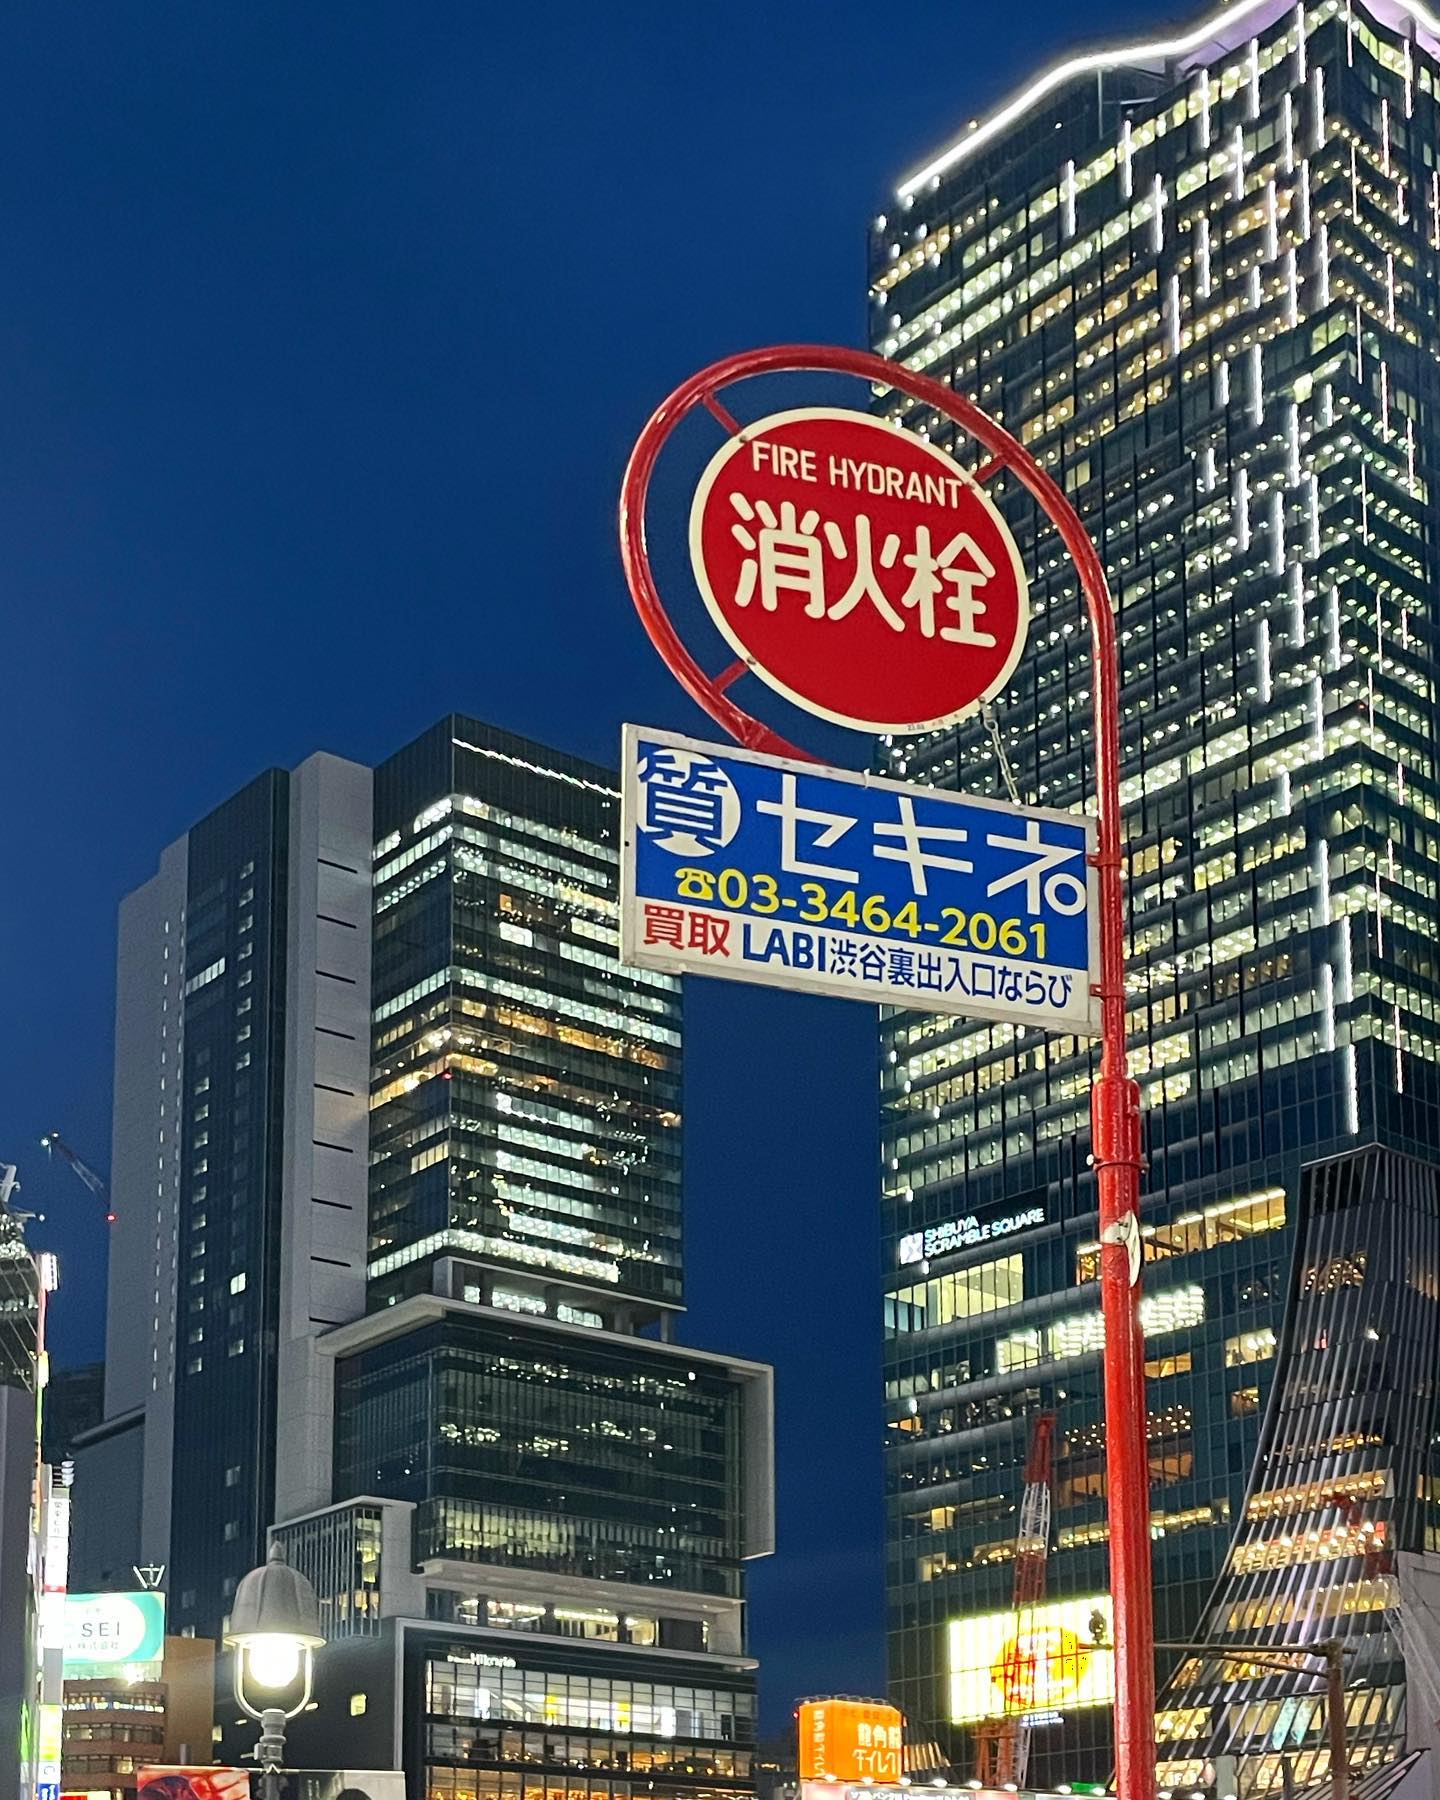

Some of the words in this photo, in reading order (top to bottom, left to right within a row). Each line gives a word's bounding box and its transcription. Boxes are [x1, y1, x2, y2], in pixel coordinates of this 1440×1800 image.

[752, 440, 817, 484] FIRE
[829, 455, 962, 509] HYDRANT
[729, 491, 997, 649] 消火栓
[637, 749, 740, 857] 質
[755, 773, 1087, 917] セキネ
[643, 904, 731, 958] 買取
[717, 867, 1047, 959] 03-3464-2061
[924, 1215, 979, 1244] SHIBUYA
[924, 1224, 991, 1257] SCRAMBLE
[991, 1207, 1046, 1237] SQUARE
